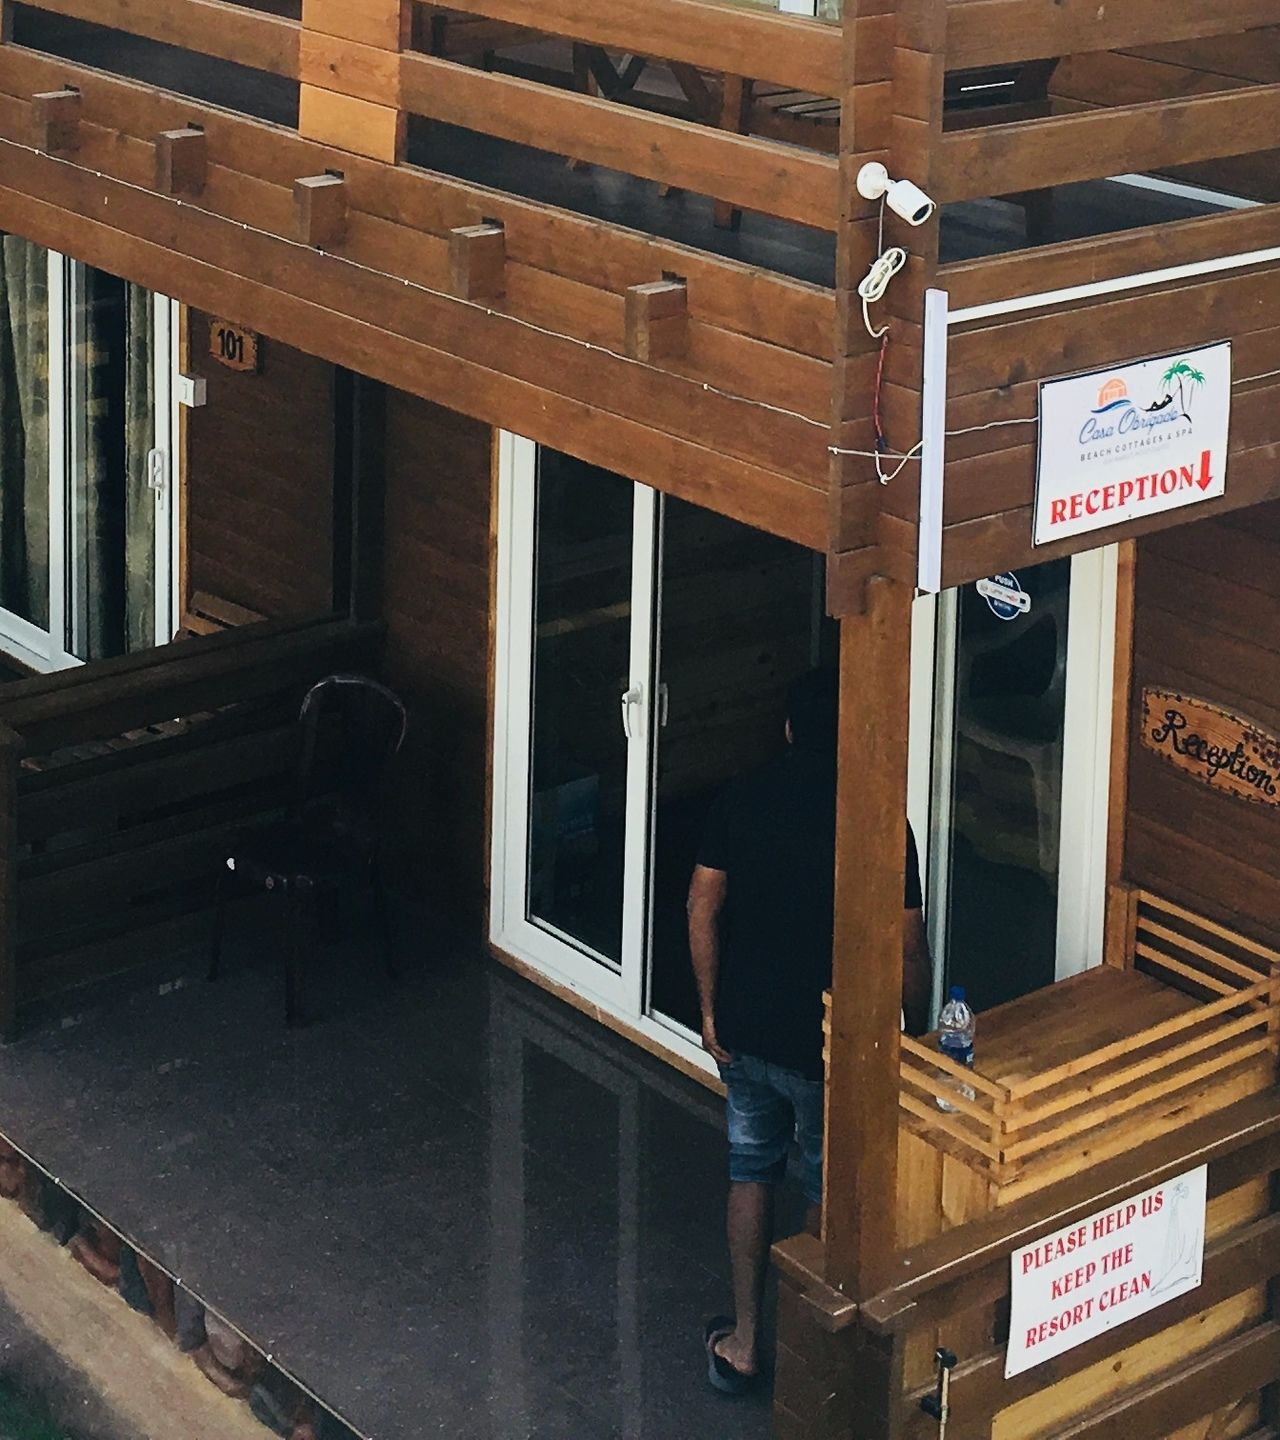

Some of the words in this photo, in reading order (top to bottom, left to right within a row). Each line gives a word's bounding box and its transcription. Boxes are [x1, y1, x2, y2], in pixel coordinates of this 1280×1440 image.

[217, 329, 243, 363] 101
[1079, 417, 1114, 445] Casa
[1080, 447, 1112, 462] BEACH
[1115, 435, 1163, 454] COTTAGES
[1176, 427, 1193, 439] SPA
[1050, 463, 1195, 525] RECEPTION
[1151, 710, 1276, 796] Reception
[1022, 1226, 1087, 1275] PLEASE
[1092, 1204, 1136, 1241] HELP
[1141, 1190, 1164, 1219] US
[1051, 1262, 1097, 1301] KEEP
[1101, 1242, 1135, 1275] THE
[1025, 1298, 1094, 1349] RESORT
[1099, 1269, 1152, 1312] CLEAN
